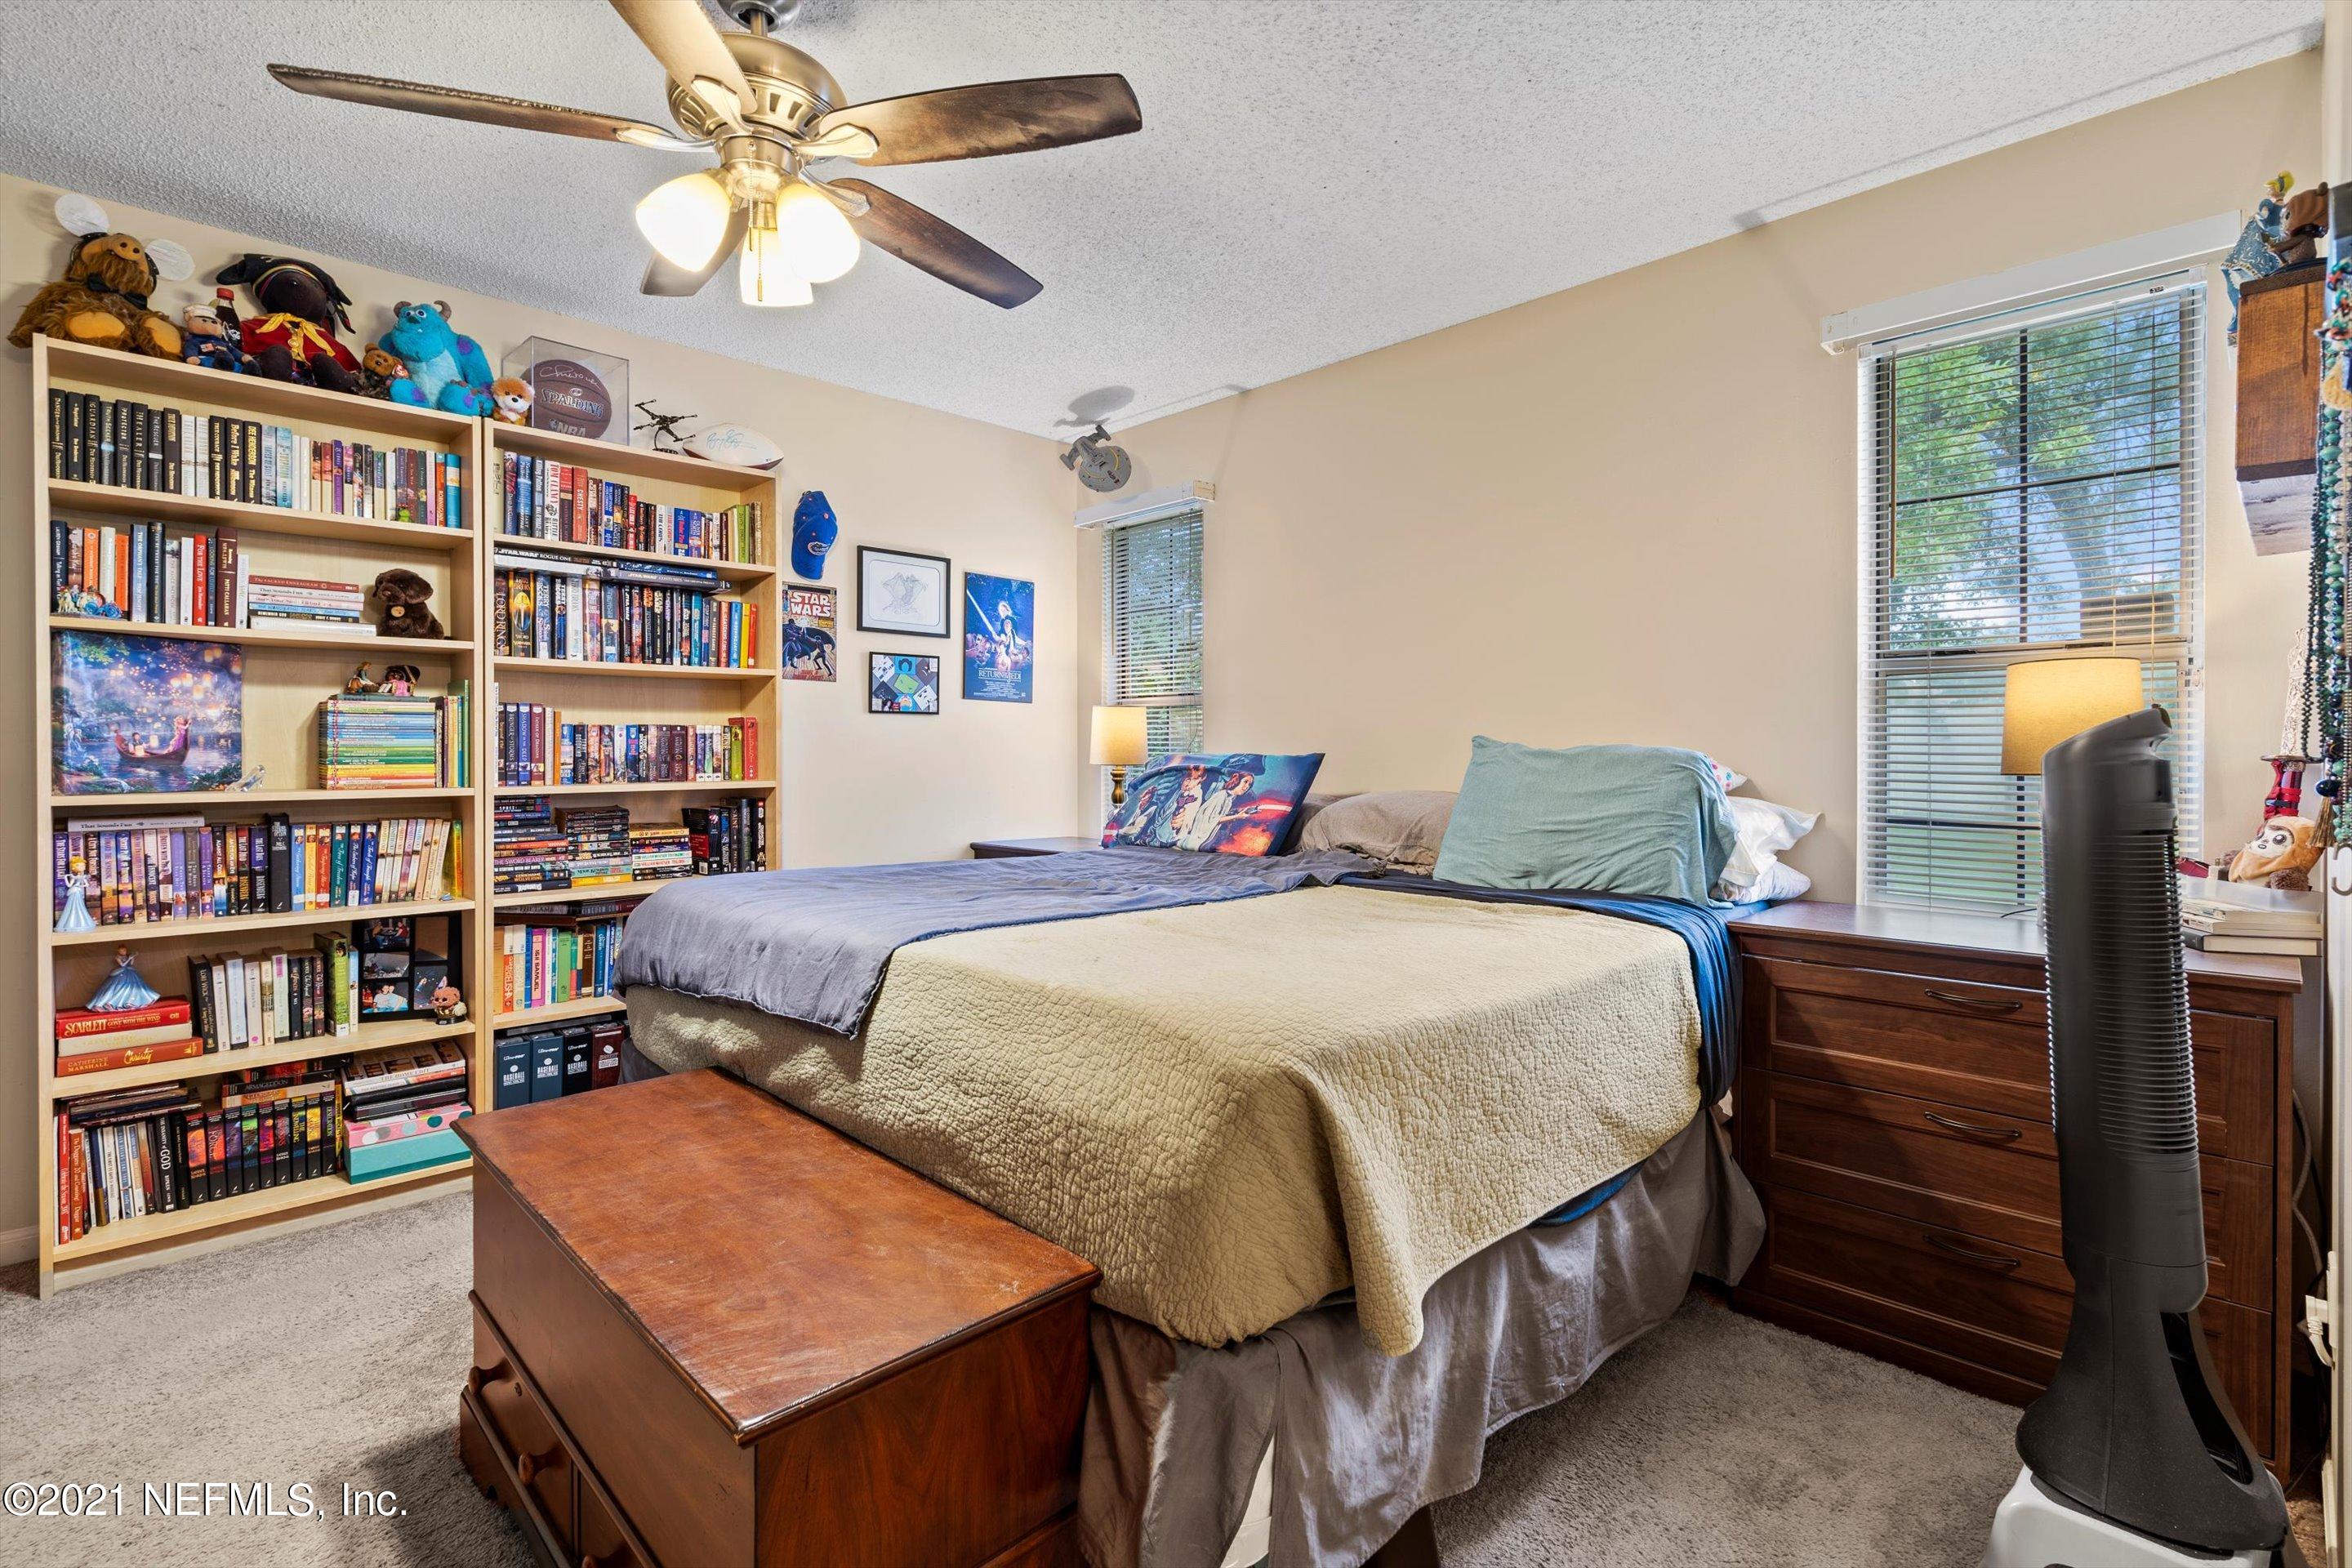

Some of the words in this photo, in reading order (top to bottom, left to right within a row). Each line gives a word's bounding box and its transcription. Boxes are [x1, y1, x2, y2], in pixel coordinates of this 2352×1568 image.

[541, 388, 604, 419] SPALDING
[135, 415, 144, 447] HEALER
[231, 425, 239, 444] Before
[248, 426, 256, 434] DEE
[231, 450, 239, 466] Wake
[248, 436, 256, 466] HENDERSON
[535, 460, 543, 474] Killing
[550, 464, 559, 478] TOM
[506, 472, 516, 494] 1776
[550, 480, 559, 505] CLANCY
[536, 579, 544, 607] BROOKS
[791, 592, 831, 606] STAR
[496, 593, 506, 621] LORD
[790, 603, 831, 617] WARS
[494, 622, 506, 650] RINGS
[978, 670, 1004, 679] RETURN
[505, 857, 526, 865] SWORD
[239, 875, 248, 899] ROSENBERG
[256, 875, 265, 899] ROSENBERG
[202, 982, 210, 997] WICK
[504, 976, 514, 999] ELISHA
[65, 1018, 108, 1037] SCARLETT
[69, 1057, 109, 1067] CATHERINE
[125, 1047, 155, 1065] Christy
[69, 1063, 109, 1073] MARSHALL
[537, 1064, 559, 1076] BASEBALL
[567, 1060, 587, 1071] BASEBALL
[245, 1078, 289, 1091] ARMAGEDDON
[503, 1071, 525, 1082] BASEBALL
[161, 1149, 171, 1169] GOD
